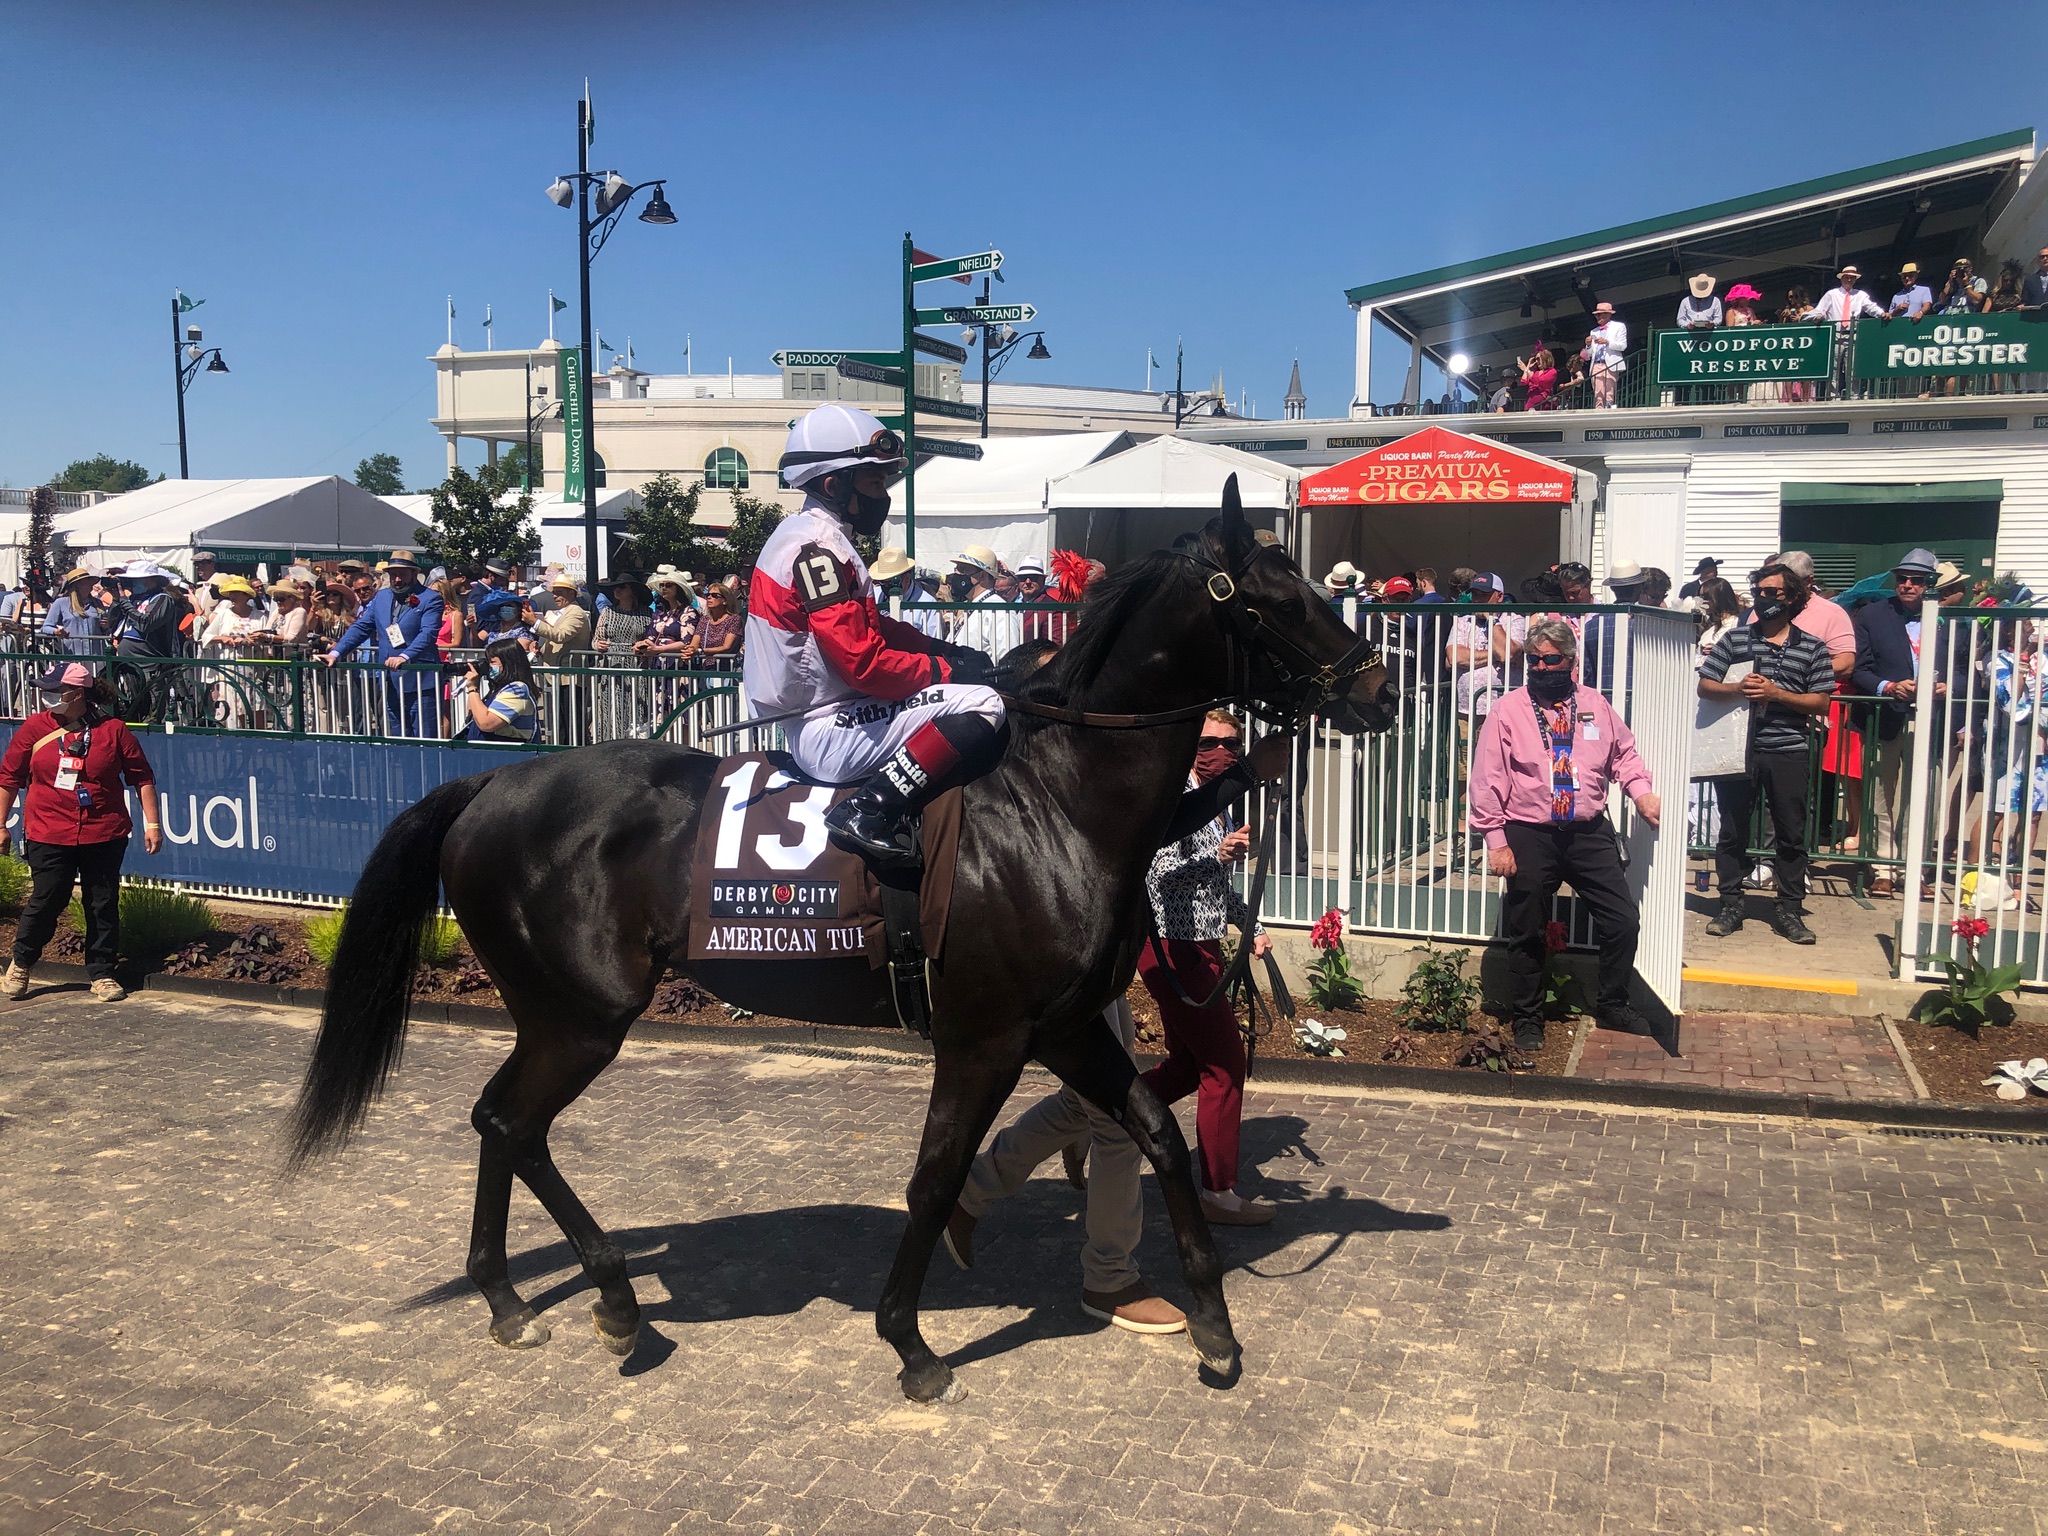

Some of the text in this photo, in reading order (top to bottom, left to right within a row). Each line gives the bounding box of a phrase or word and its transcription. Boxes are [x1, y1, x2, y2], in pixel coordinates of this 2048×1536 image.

[958, 256, 991, 272] INFIELD
[944, 308, 1020, 322] GRANDSTAND
[1933, 325, 1984, 345] OLD
[1677, 336, 1813, 353] WOODFORD
[1887, 343, 2027, 368] FORESTER
[846, 363, 886, 381] CLUBHOUSE
[1690, 358, 1800, 373] RESERVE
[566, 356, 582, 473] CHURCHILL DOWNS
[915, 400, 976, 416] KENTUCKY DERBY MUSEUM
[1727, 425, 1808, 436] 1951 COUNT TURF
[1877, 420, 1952, 431] 1952 HILL GAIL
[1588, 428, 1680, 440] 1950 MIDDLEGROUND
[923, 442, 975, 456] JOCKEY CLUB SUITES
[1244, 442, 1266, 451] PILOT
[1328, 437, 1381, 448] 1948 CITATION
[1380, 453, 1410, 461] LIQUOR
[1411, 452, 1432, 460] BARN
[1358, 479, 1510, 502] CIGARS
[218, 551, 276, 562] Bluegrass Grill
[312, 553, 347, 562] Bluegrass
[799, 555, 840, 601] 13
[834, 689, 945, 730] Smithfield
[895, 745, 928, 788] Smith
[879, 760, 915, 797] field
[714, 761, 836, 870] 13
[713, 886, 838, 904] DERBY CITY
[736, 906, 815, 915] GAMING
[706, 926, 816, 952] AMERICAN
